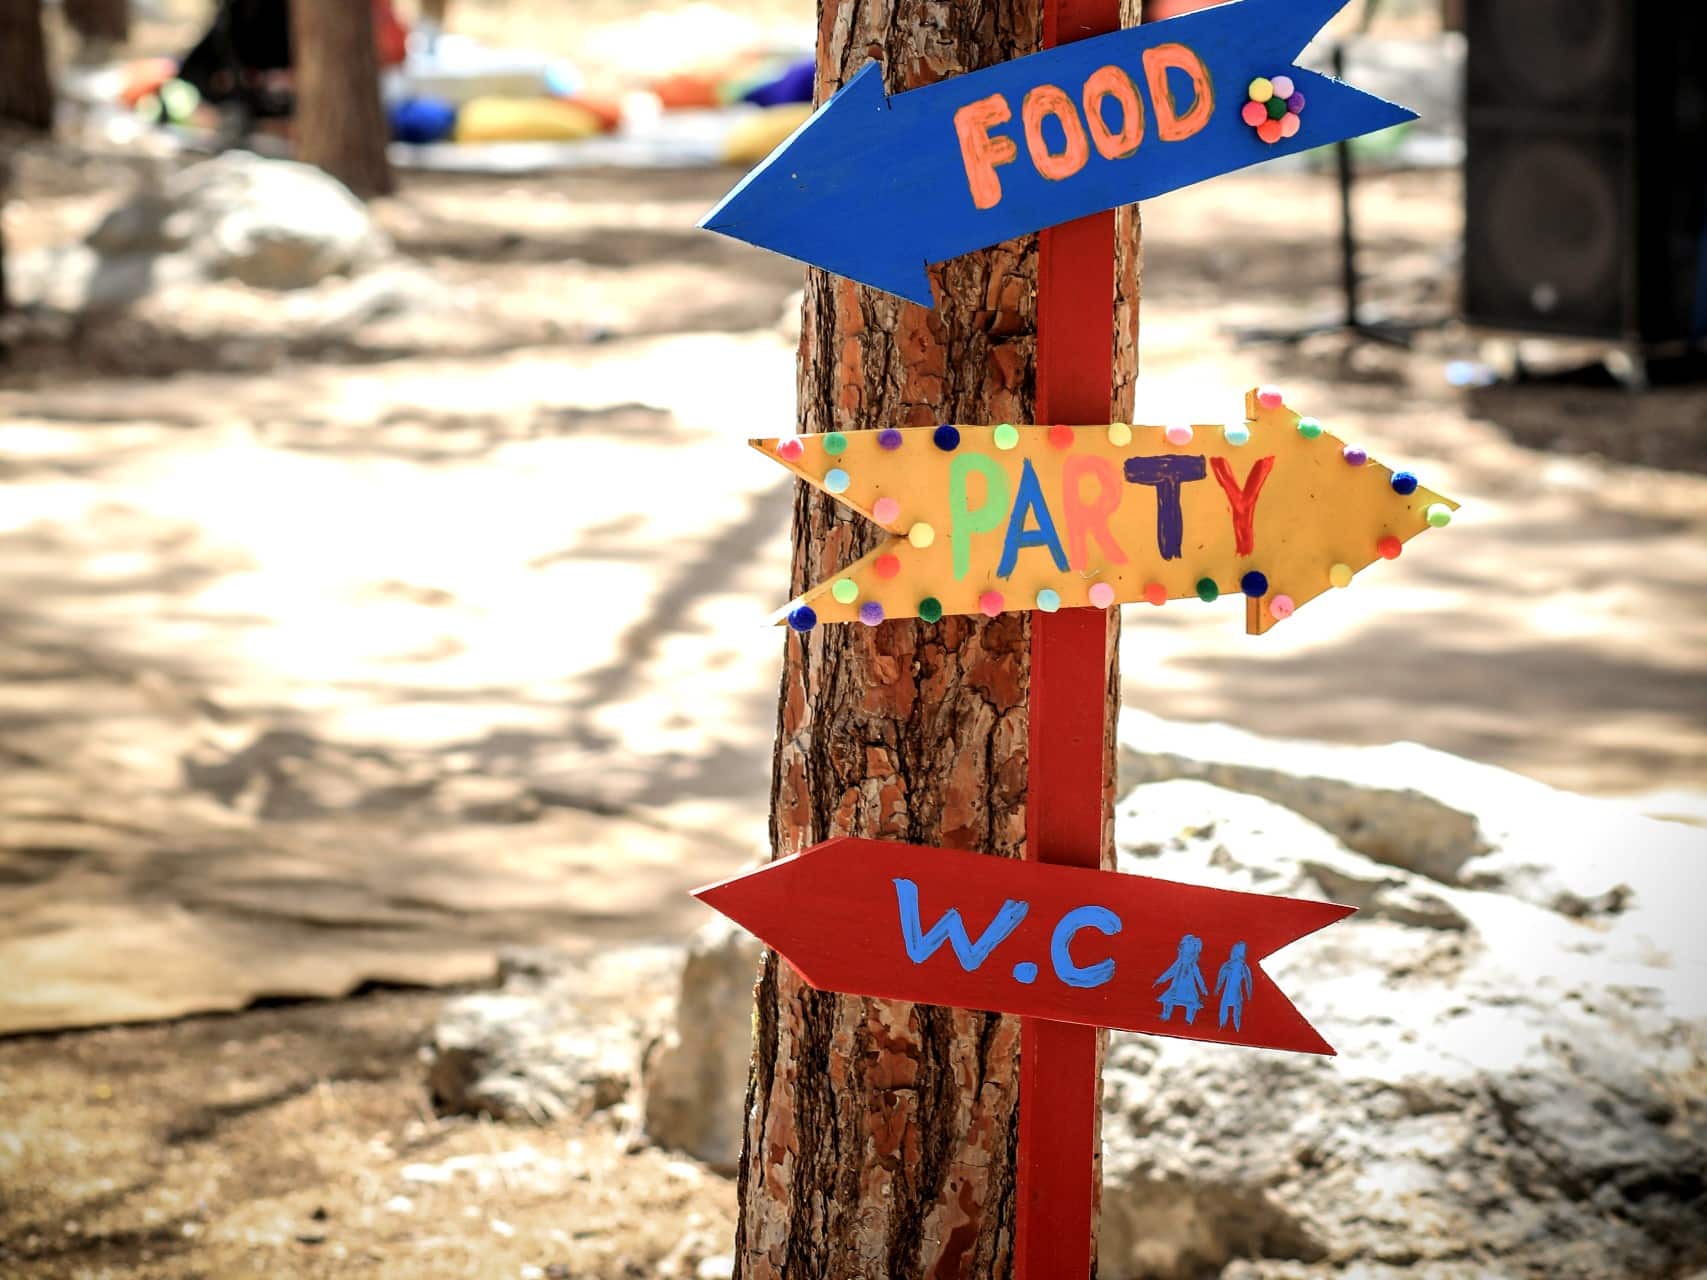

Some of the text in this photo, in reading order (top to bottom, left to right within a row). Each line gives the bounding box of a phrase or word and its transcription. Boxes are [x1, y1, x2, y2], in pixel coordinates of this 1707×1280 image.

[953, 42, 1215, 210] FOOD
[948, 452, 1276, 582] PARTY
[892, 878, 1122, 989] W.C
